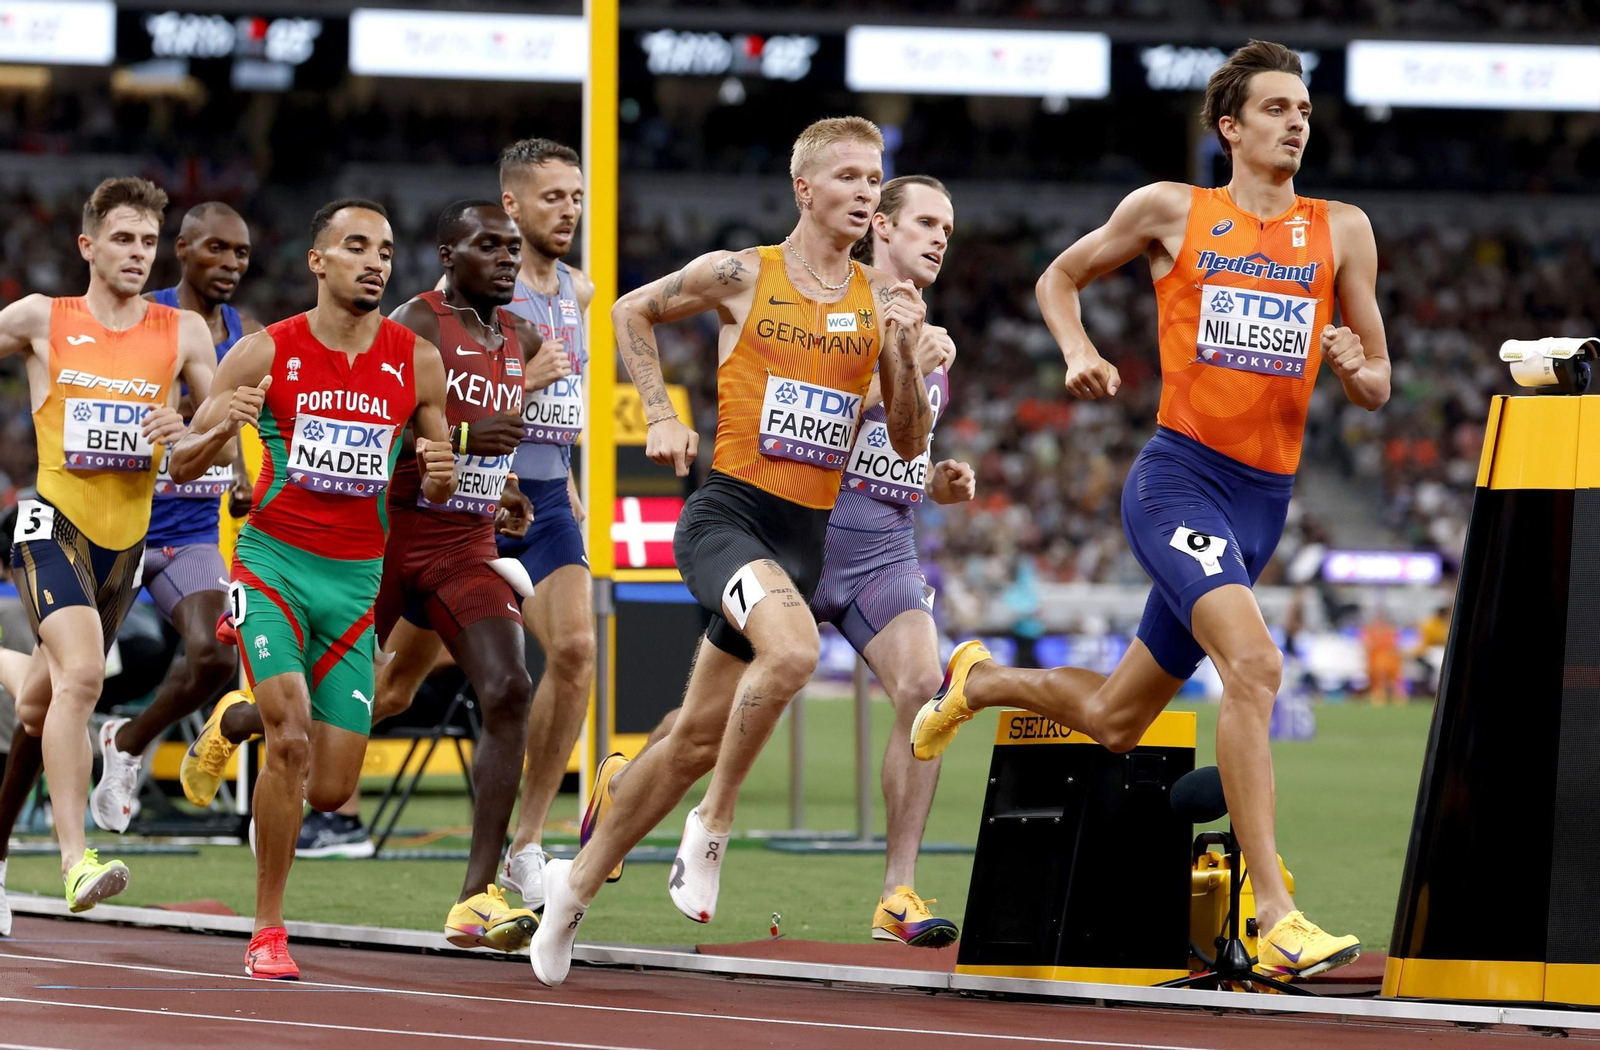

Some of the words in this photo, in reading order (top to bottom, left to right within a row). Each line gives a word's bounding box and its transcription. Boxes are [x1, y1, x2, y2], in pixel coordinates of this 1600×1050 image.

[828, 318, 855, 327] WGV
[1235, 292, 1310, 325] TDK
[757, 319, 874, 357] GERMANY
[1204, 319, 1308, 356] NILLESSEN
[56, 368, 161, 399] ESPAÑA
[296, 390, 391, 420] PORTUGAL
[521, 401, 581, 426] OURLEY
[800, 385, 860, 420] TDK
[87, 428, 138, 452] BEN
[325, 422, 387, 449] TDK
[767, 409, 852, 448] FARKEN
[296, 444, 383, 476] NADER
[854, 450, 927, 486] HOCKE
[23, 507, 42, 535] 5
[729, 577, 747, 614] 7
